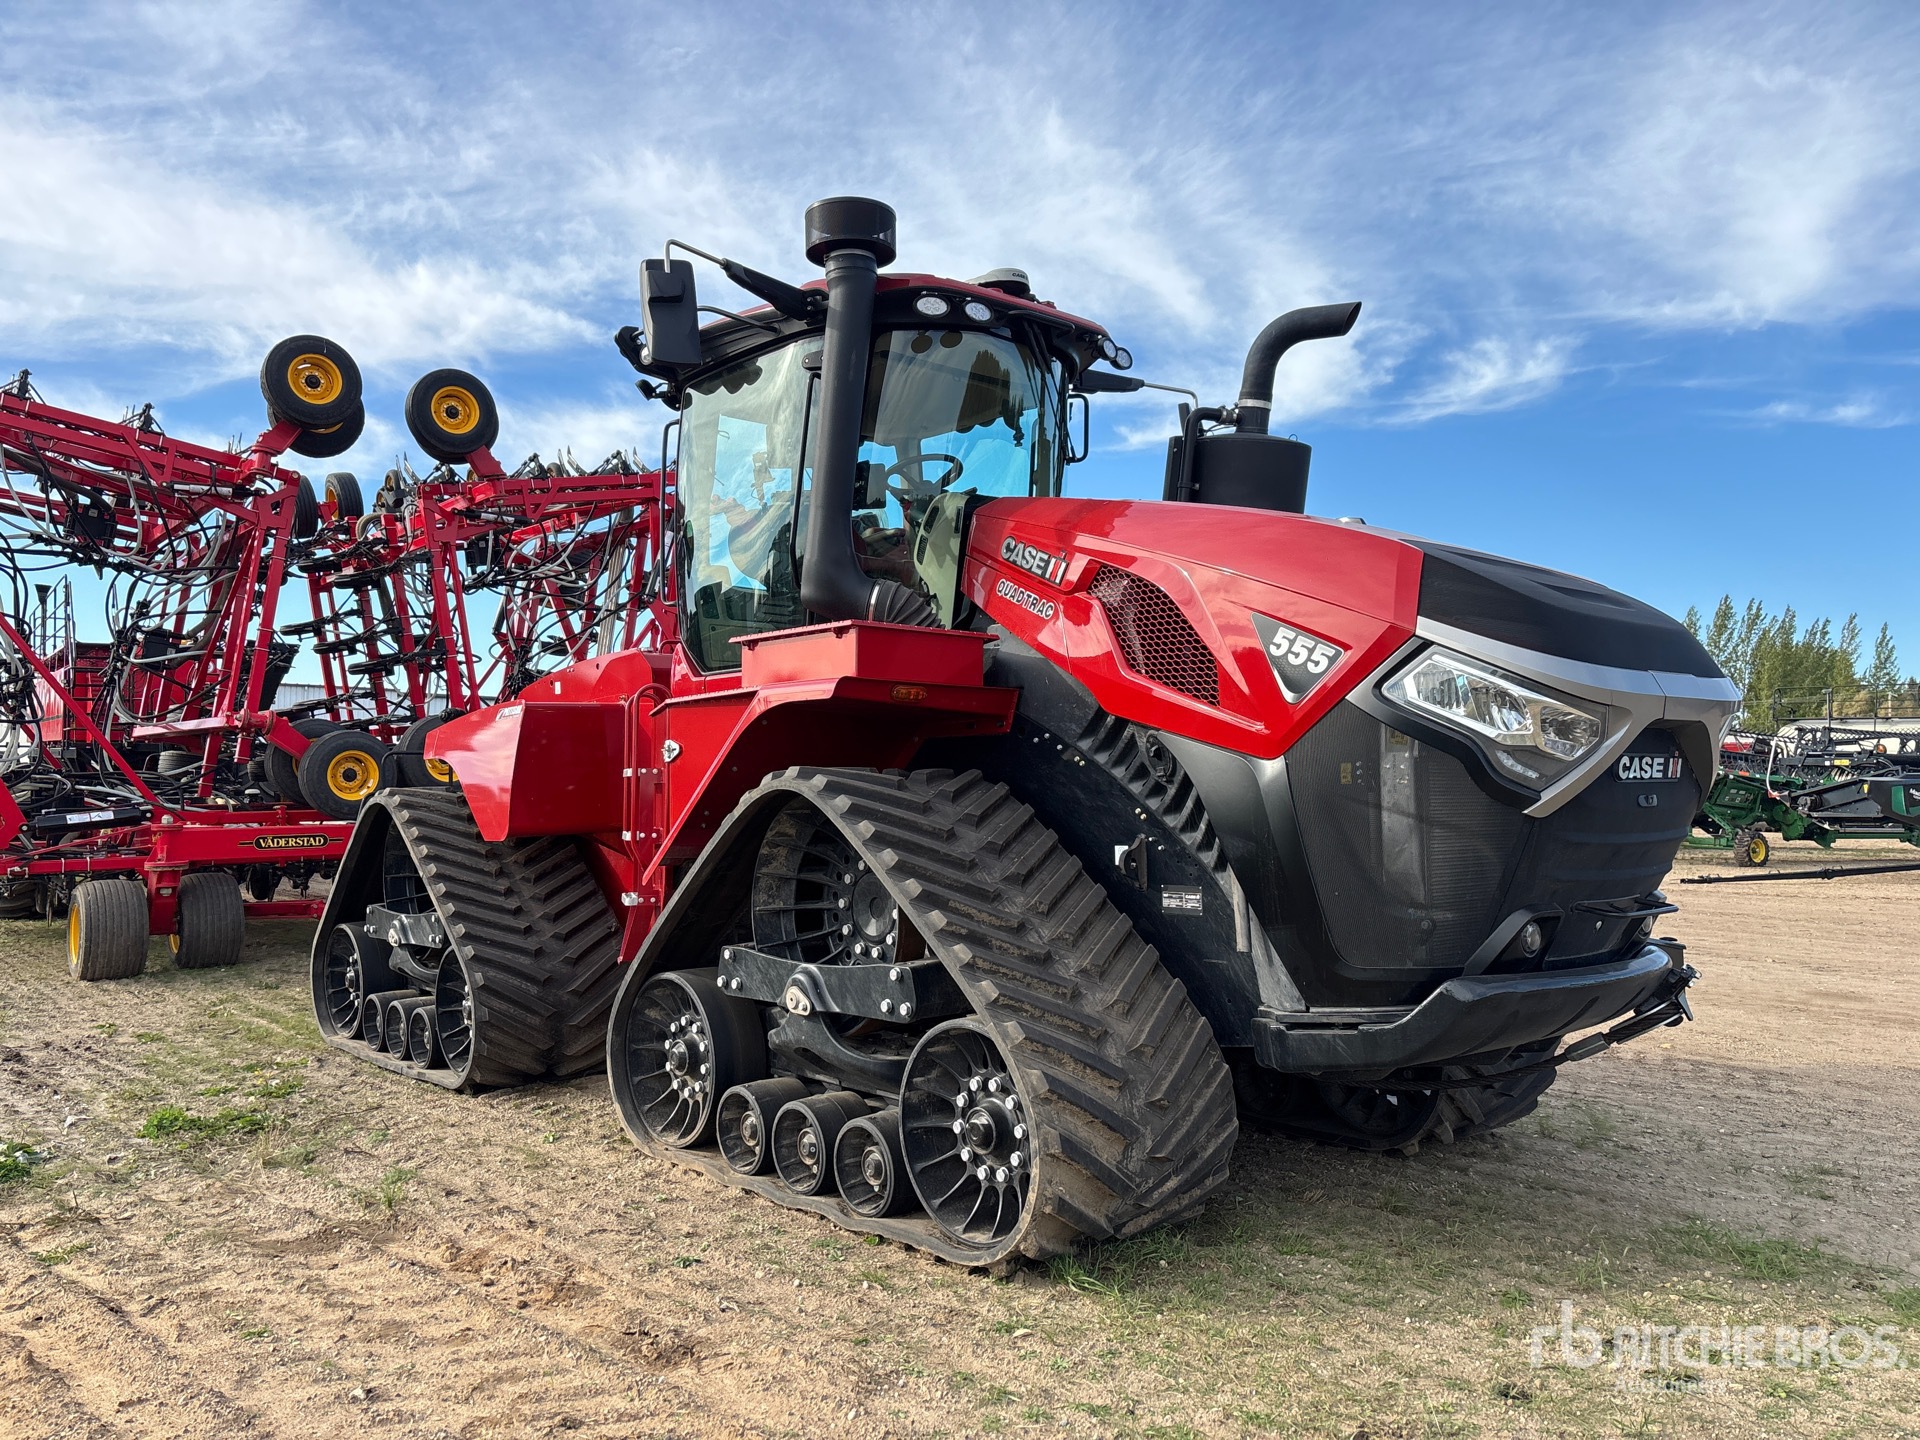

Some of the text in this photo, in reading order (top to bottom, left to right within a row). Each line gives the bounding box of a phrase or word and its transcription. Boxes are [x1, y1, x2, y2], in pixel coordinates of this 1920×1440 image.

[1001, 536, 1050, 576] CASE
[996, 579, 1055, 619] QUADTRAC
[1269, 626, 1336, 674] 555
[1618, 755, 1664, 780] CASE
[259, 836, 324, 848] VÄDERSTAD
